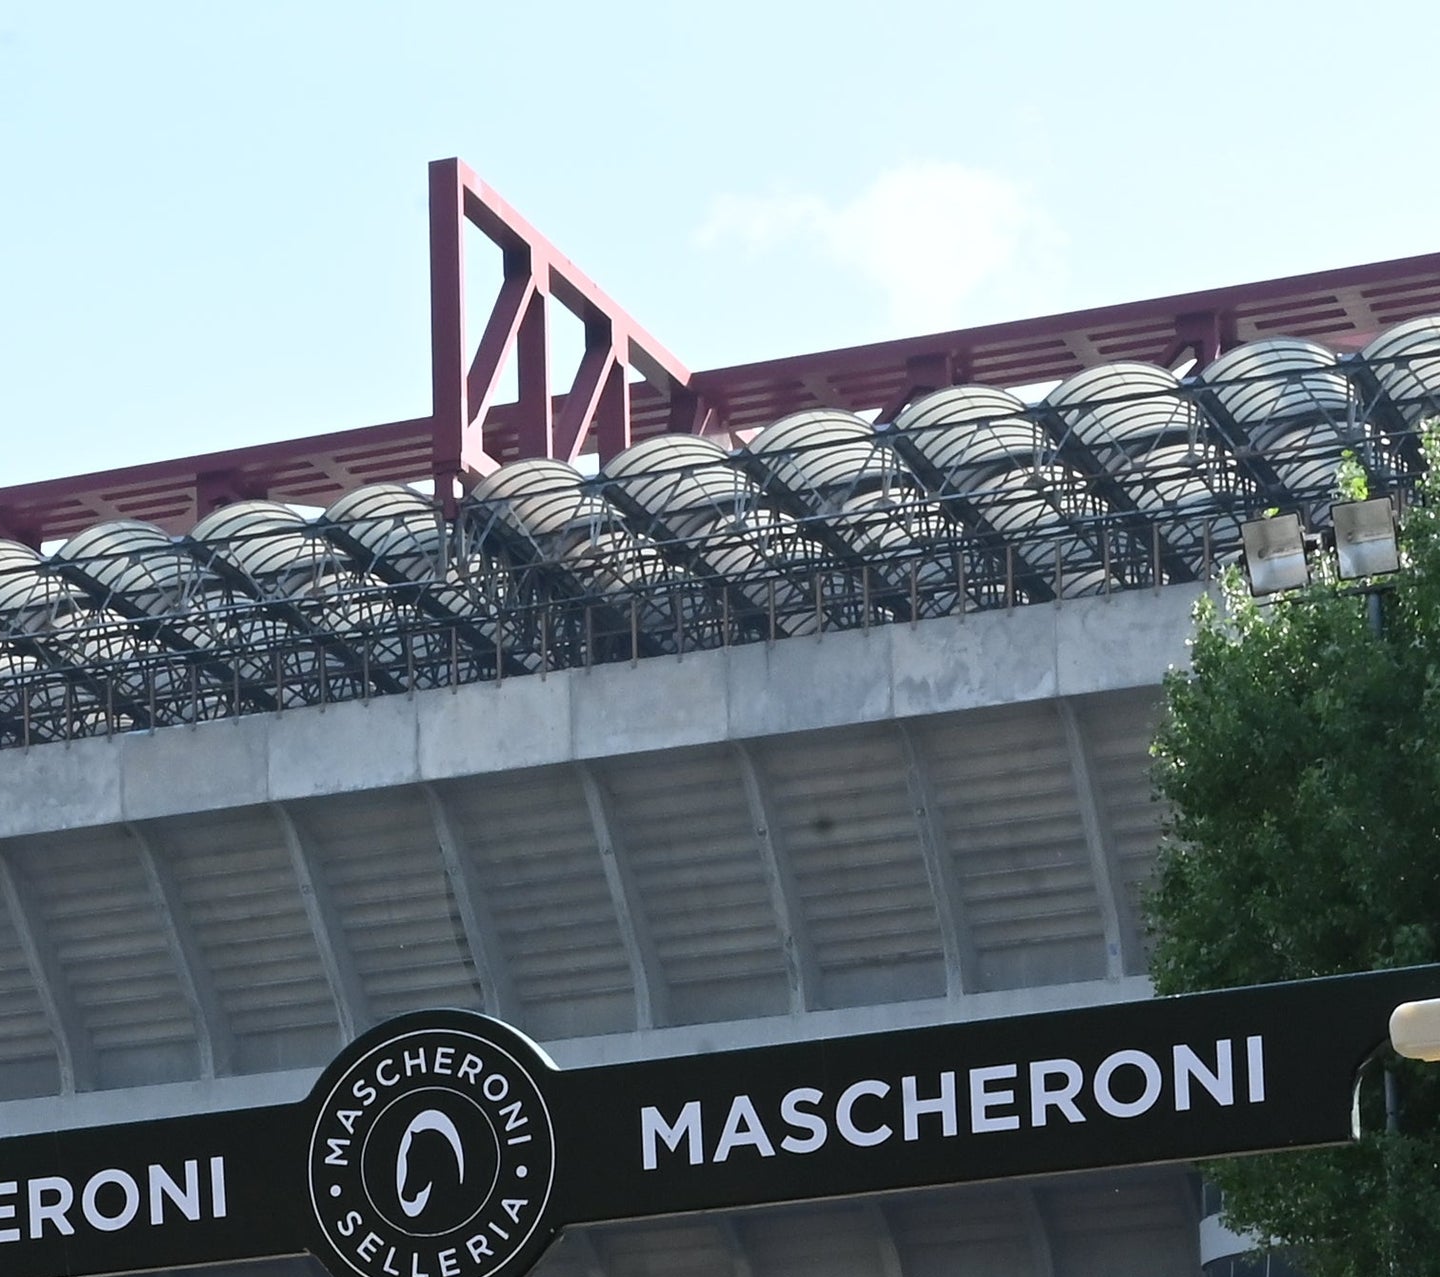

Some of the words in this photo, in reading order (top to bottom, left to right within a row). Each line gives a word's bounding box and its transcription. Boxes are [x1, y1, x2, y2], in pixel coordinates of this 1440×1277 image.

[324, 1047, 532, 1166] MASCHERONI
[641, 1035, 1266, 1170] MASCHERONI
[337, 1198, 528, 1277] SELLERIA
